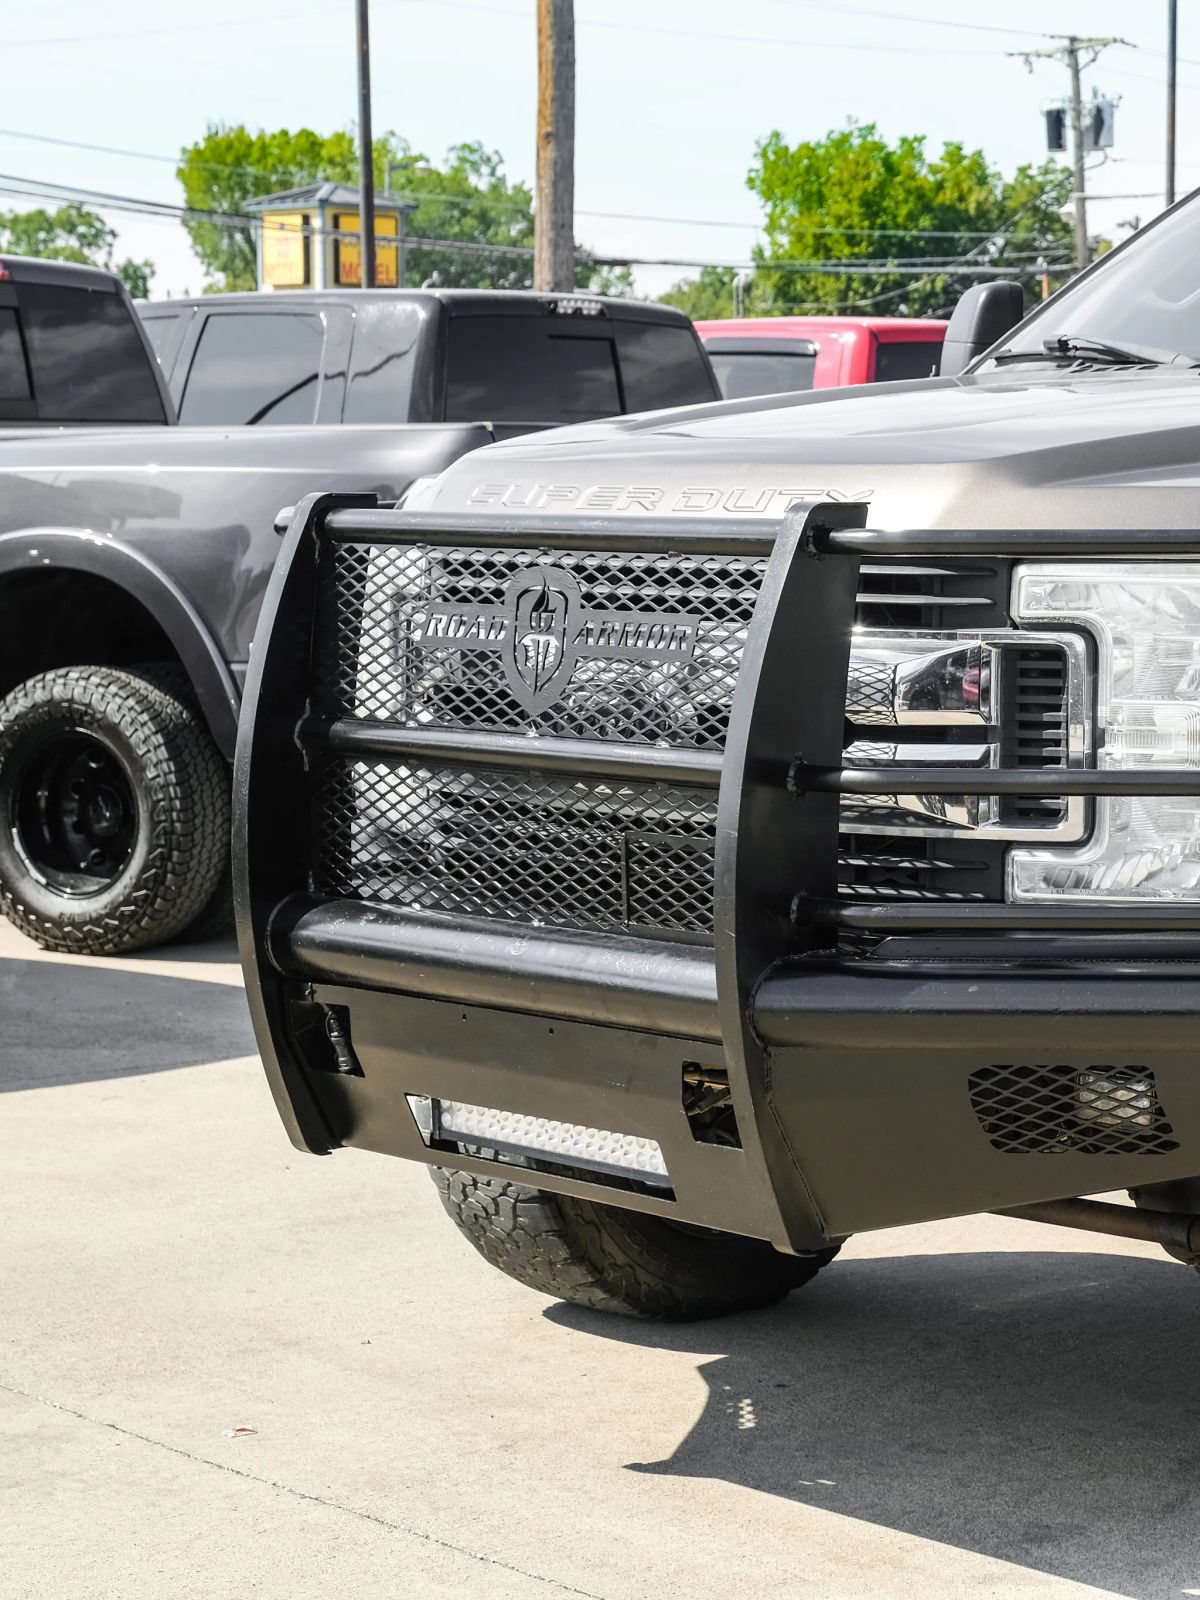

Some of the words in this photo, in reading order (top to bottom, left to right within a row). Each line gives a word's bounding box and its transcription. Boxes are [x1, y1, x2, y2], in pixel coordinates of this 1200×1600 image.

[341, 263, 394, 281] MOEL
[467, 483, 665, 511] SUPER
[671, 486, 875, 513] DUTY
[424, 612, 510, 641] ROAD
[572, 619, 697, 651] ARMOR
